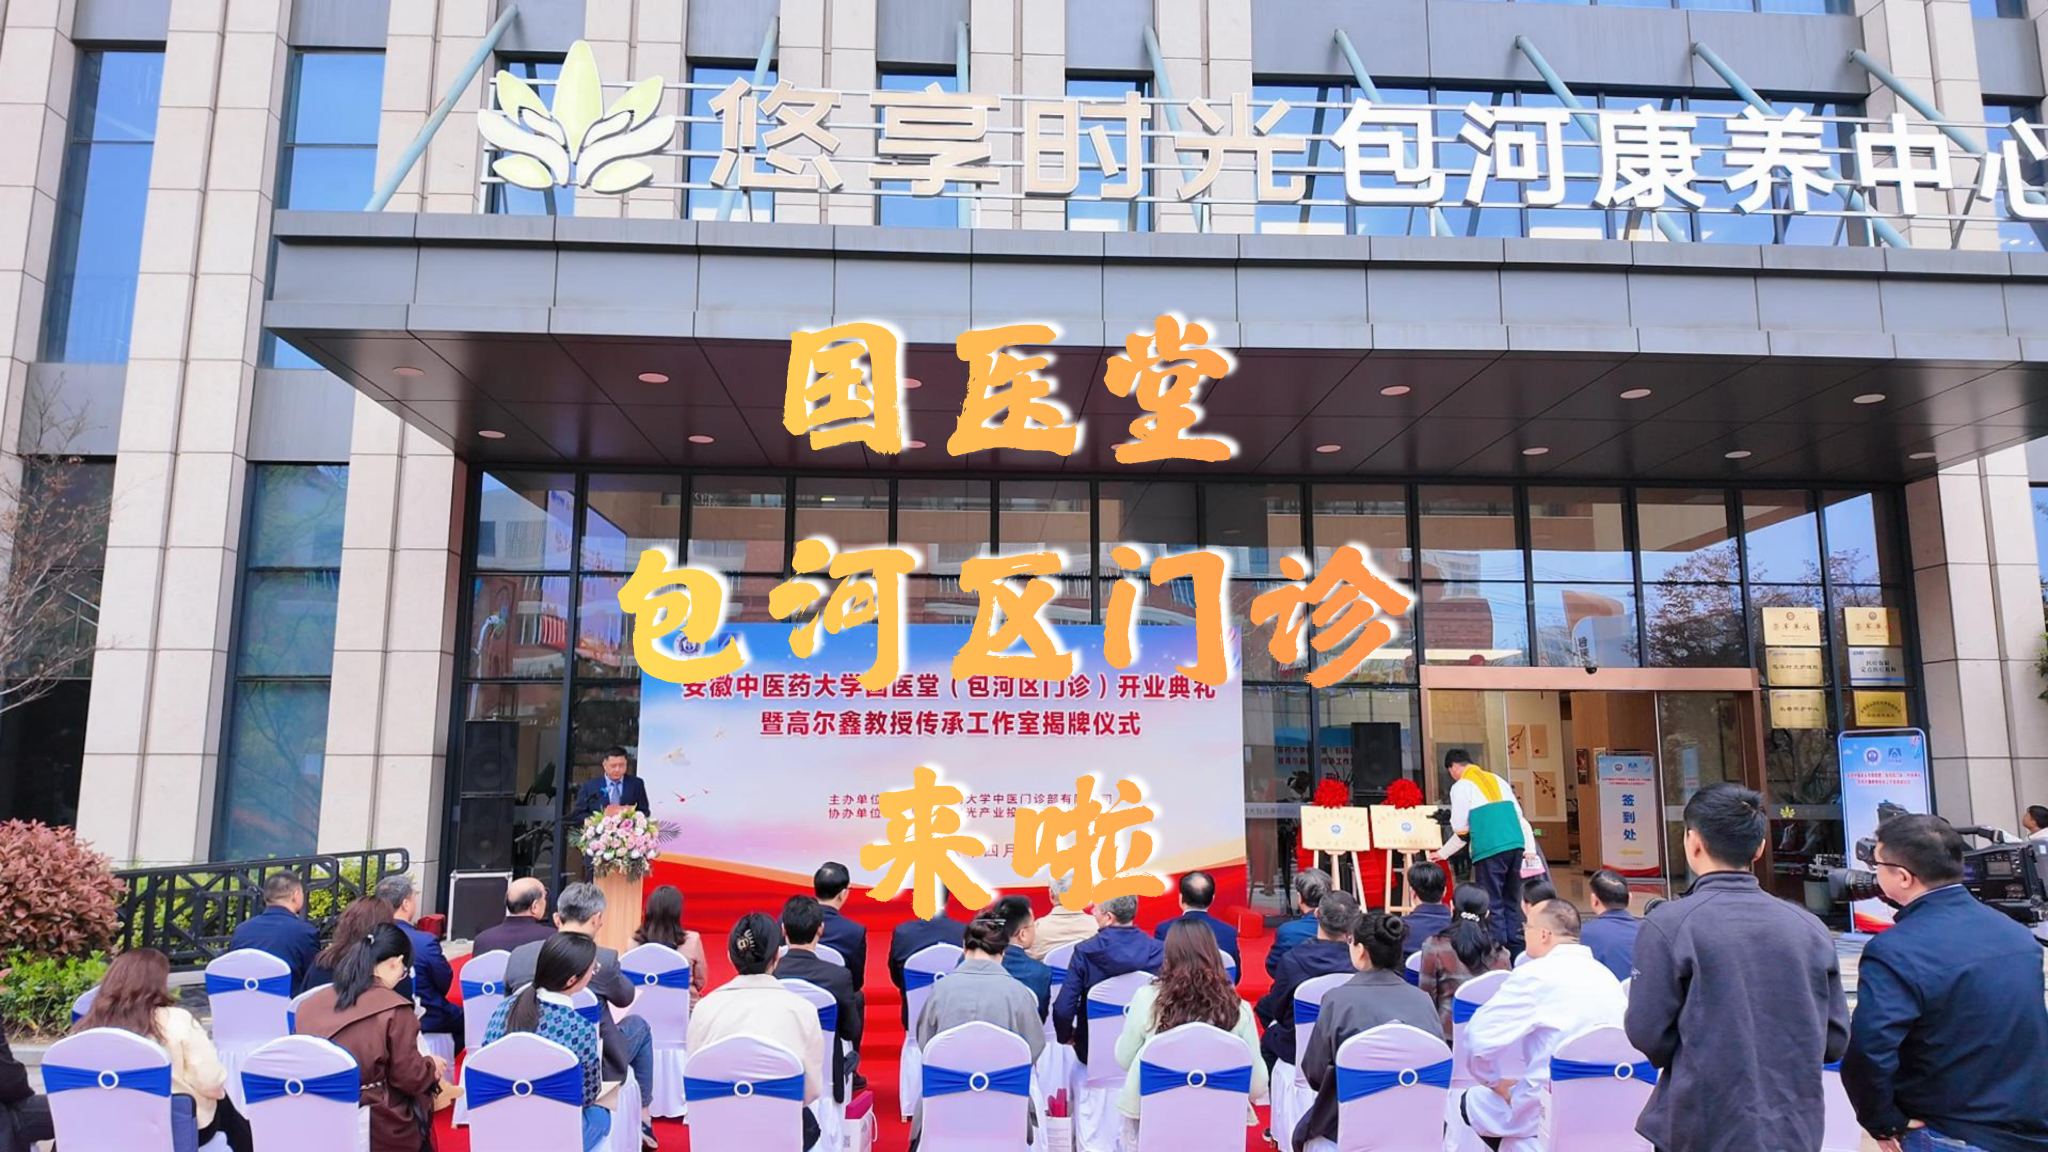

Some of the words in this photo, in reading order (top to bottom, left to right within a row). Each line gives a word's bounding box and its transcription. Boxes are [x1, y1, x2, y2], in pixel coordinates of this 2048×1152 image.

[760, 710, 1141, 736] 暨高尔鑫教授传承工作室揭牌仪式
[1621, 794, 1637, 841] 签到处
